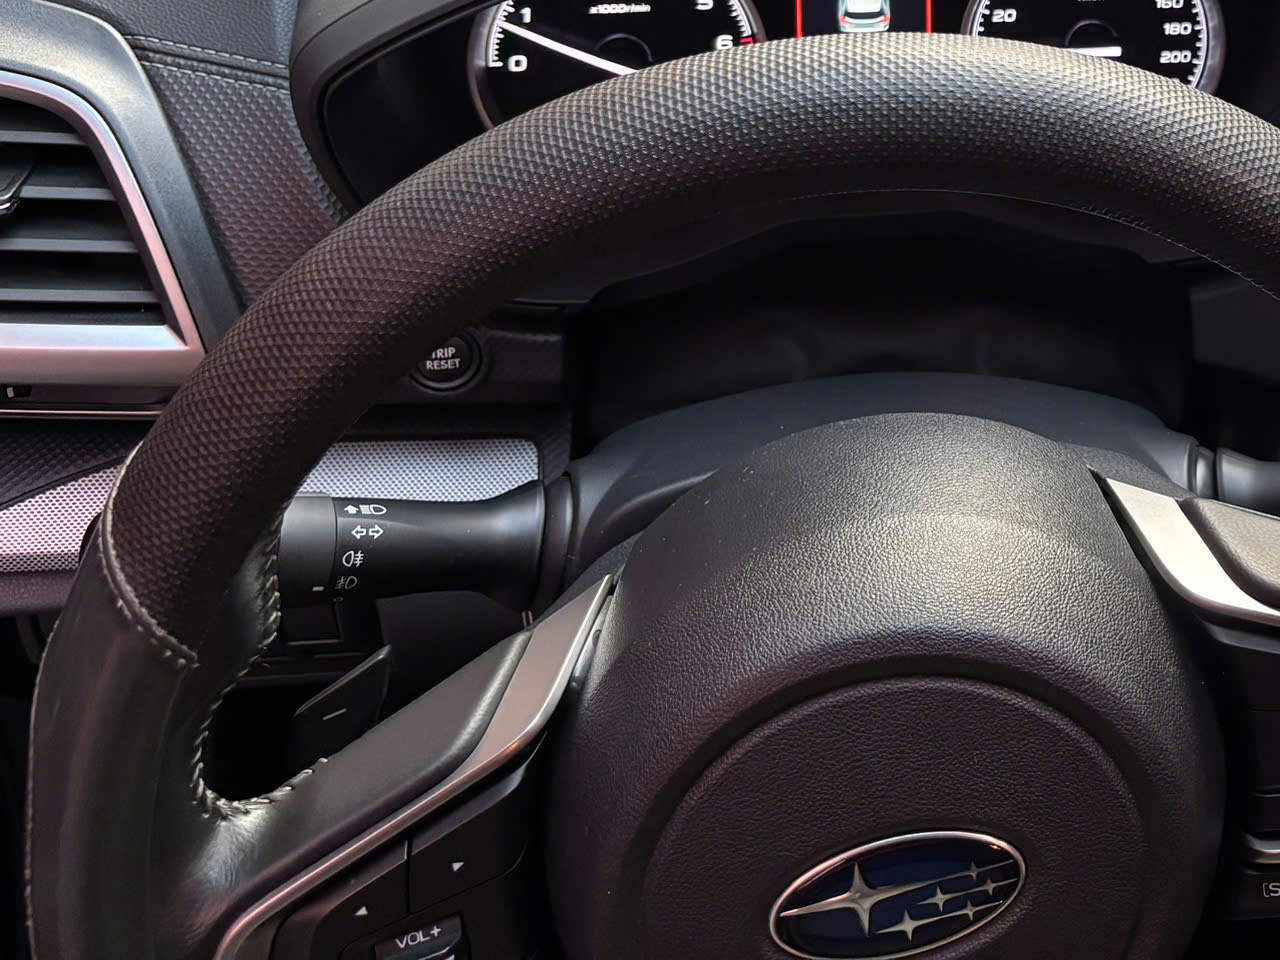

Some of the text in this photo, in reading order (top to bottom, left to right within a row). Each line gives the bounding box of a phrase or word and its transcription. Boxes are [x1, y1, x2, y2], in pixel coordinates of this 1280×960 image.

[519, 7, 532, 23] 1
[991, 9, 1017, 23] 20
[1163, 21, 1192, 35] 180
[715, 35, 734, 50] 6
[507, 55, 528, 72] 0
[1159, 50, 1192, 64] 200
[426, 358, 461, 370] RESET
